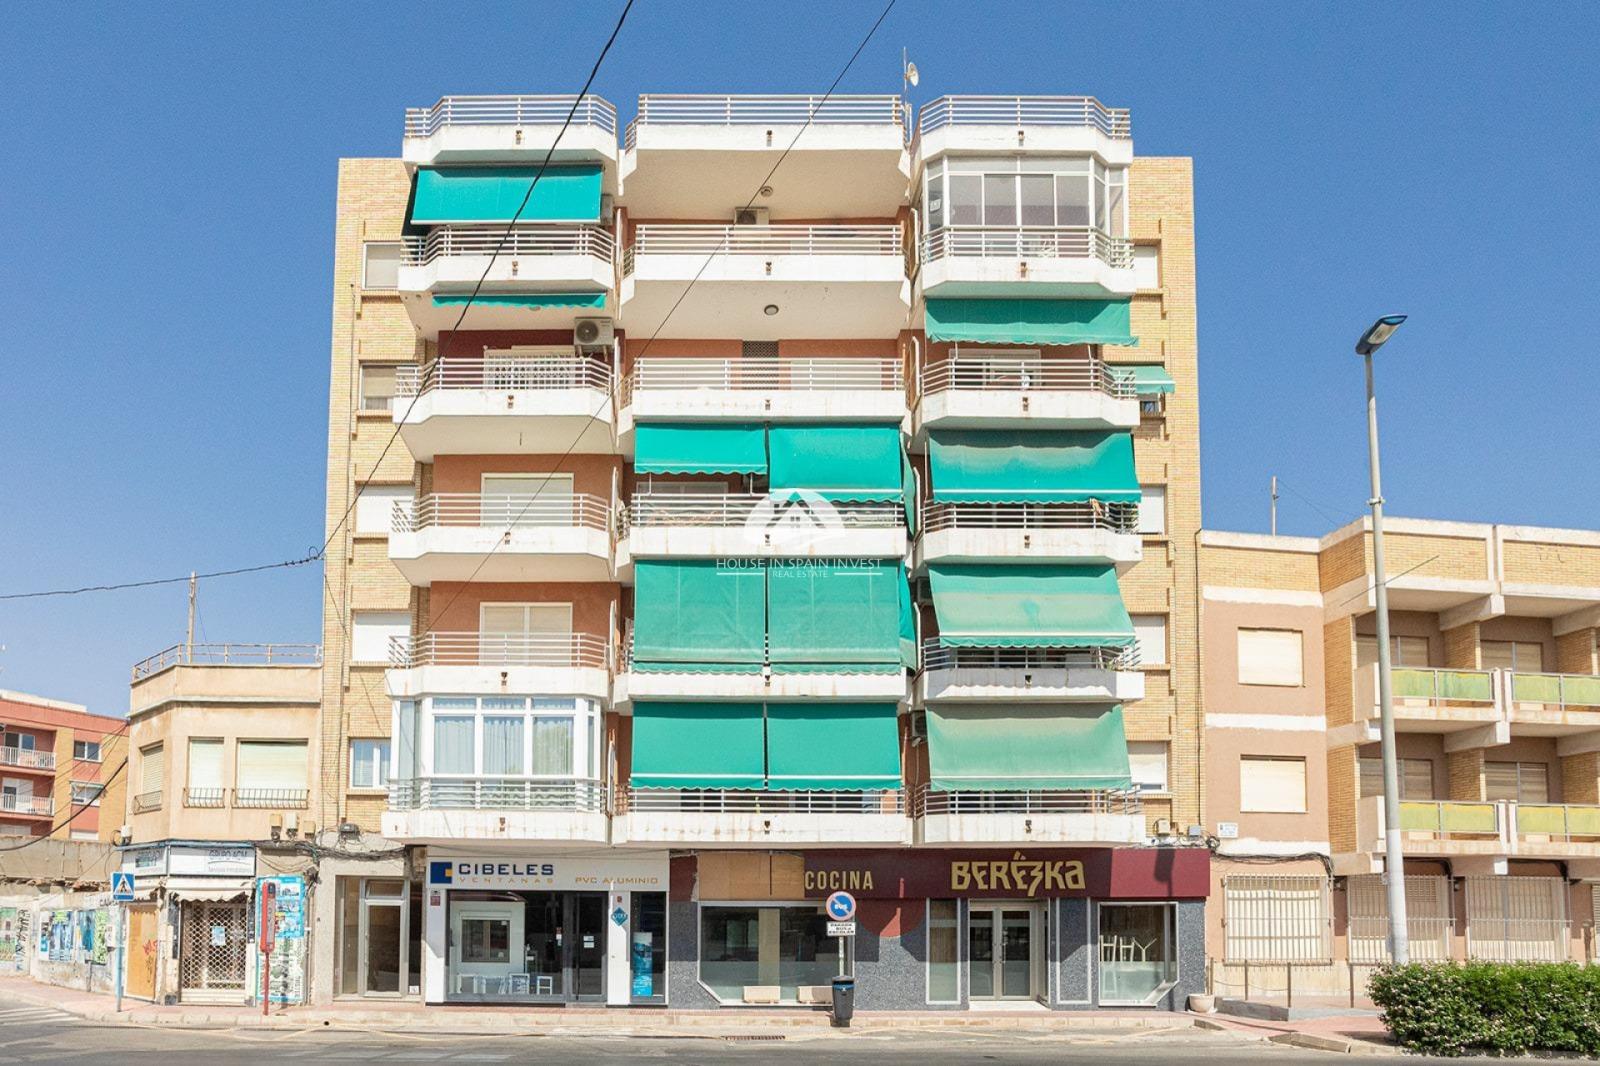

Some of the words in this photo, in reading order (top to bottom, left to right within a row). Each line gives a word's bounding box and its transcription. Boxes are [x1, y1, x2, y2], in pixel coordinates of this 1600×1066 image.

[458, 863, 554, 876] CIBELES
[458, 877, 554, 885] VENTANAS
[575, 876, 598, 884] PVC
[602, 876, 659, 884] ALUMINIO
[804, 870, 874, 890] COCINA
